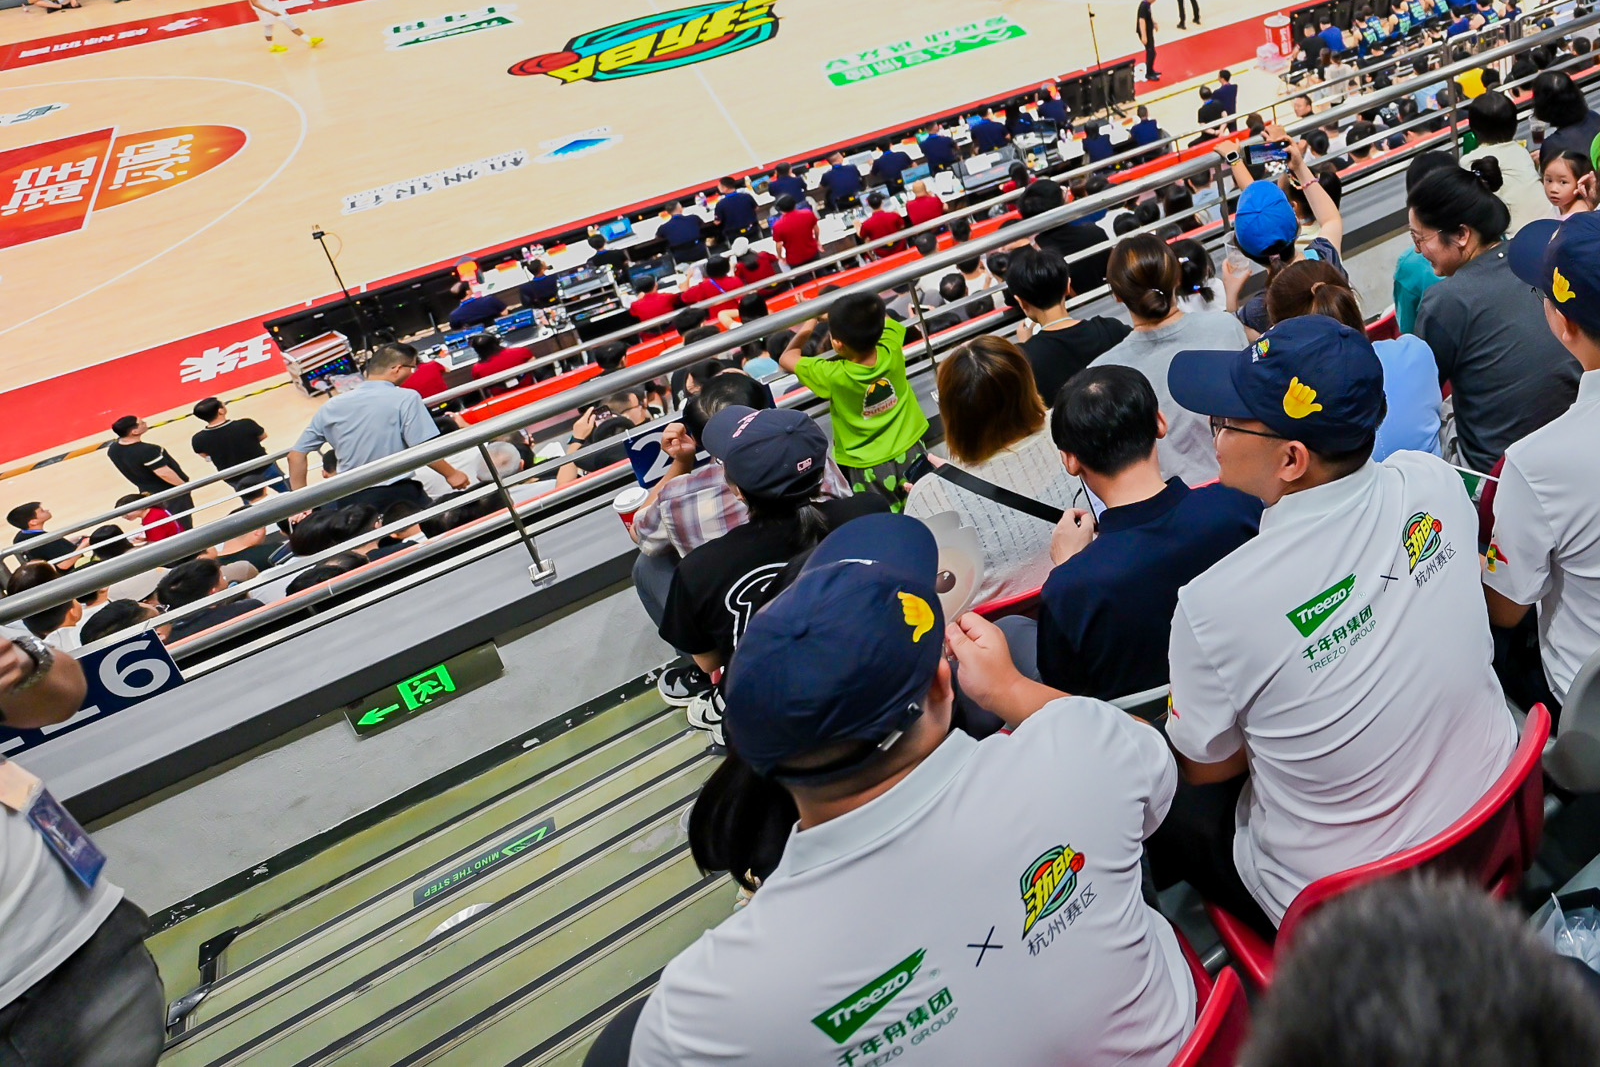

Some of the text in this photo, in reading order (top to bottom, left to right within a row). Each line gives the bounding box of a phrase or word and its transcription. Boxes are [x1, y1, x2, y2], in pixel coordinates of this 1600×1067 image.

[1415, 542, 1457, 588] 杭州赛区
[1297, 588, 1347, 624] Treezo
[1302, 604, 1373, 661] 千年舟集团
[1307, 619, 1377, 673] TREEZO GROUP
[424, 851, 500, 897] MIND THE STEP
[1027, 882, 1098, 957] 杭州赛区
[827, 968, 909, 1028] Treezo
[837, 986, 953, 1067] 千年舟集团
[910, 1006, 959, 1046] GROUP
